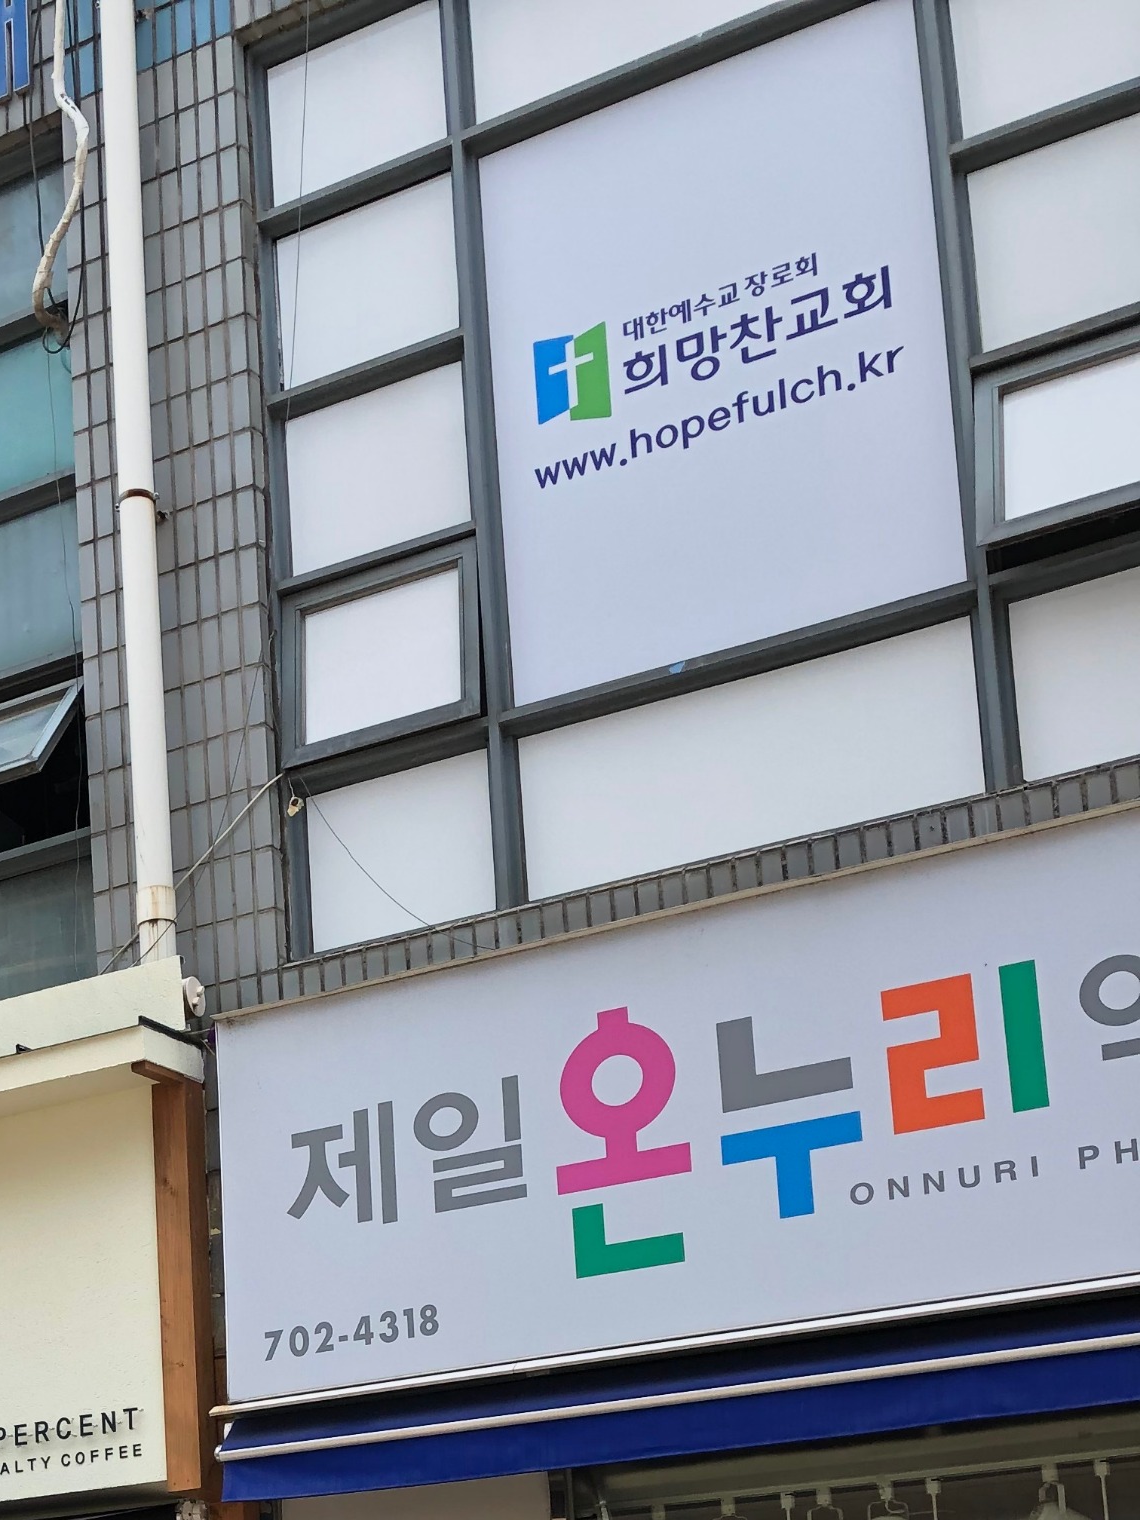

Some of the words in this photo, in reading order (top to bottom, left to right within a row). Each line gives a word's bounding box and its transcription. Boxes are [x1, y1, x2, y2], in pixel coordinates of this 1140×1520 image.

[623, 265, 893, 394] 희망찬교회
[534, 345, 904, 489] www.hopefulch.kr
[850, 1155, 1039, 1206] ONNURI
[263, 1304, 440, 1362] 702-4318
[61, 1443, 143, 1467] COFFEE
